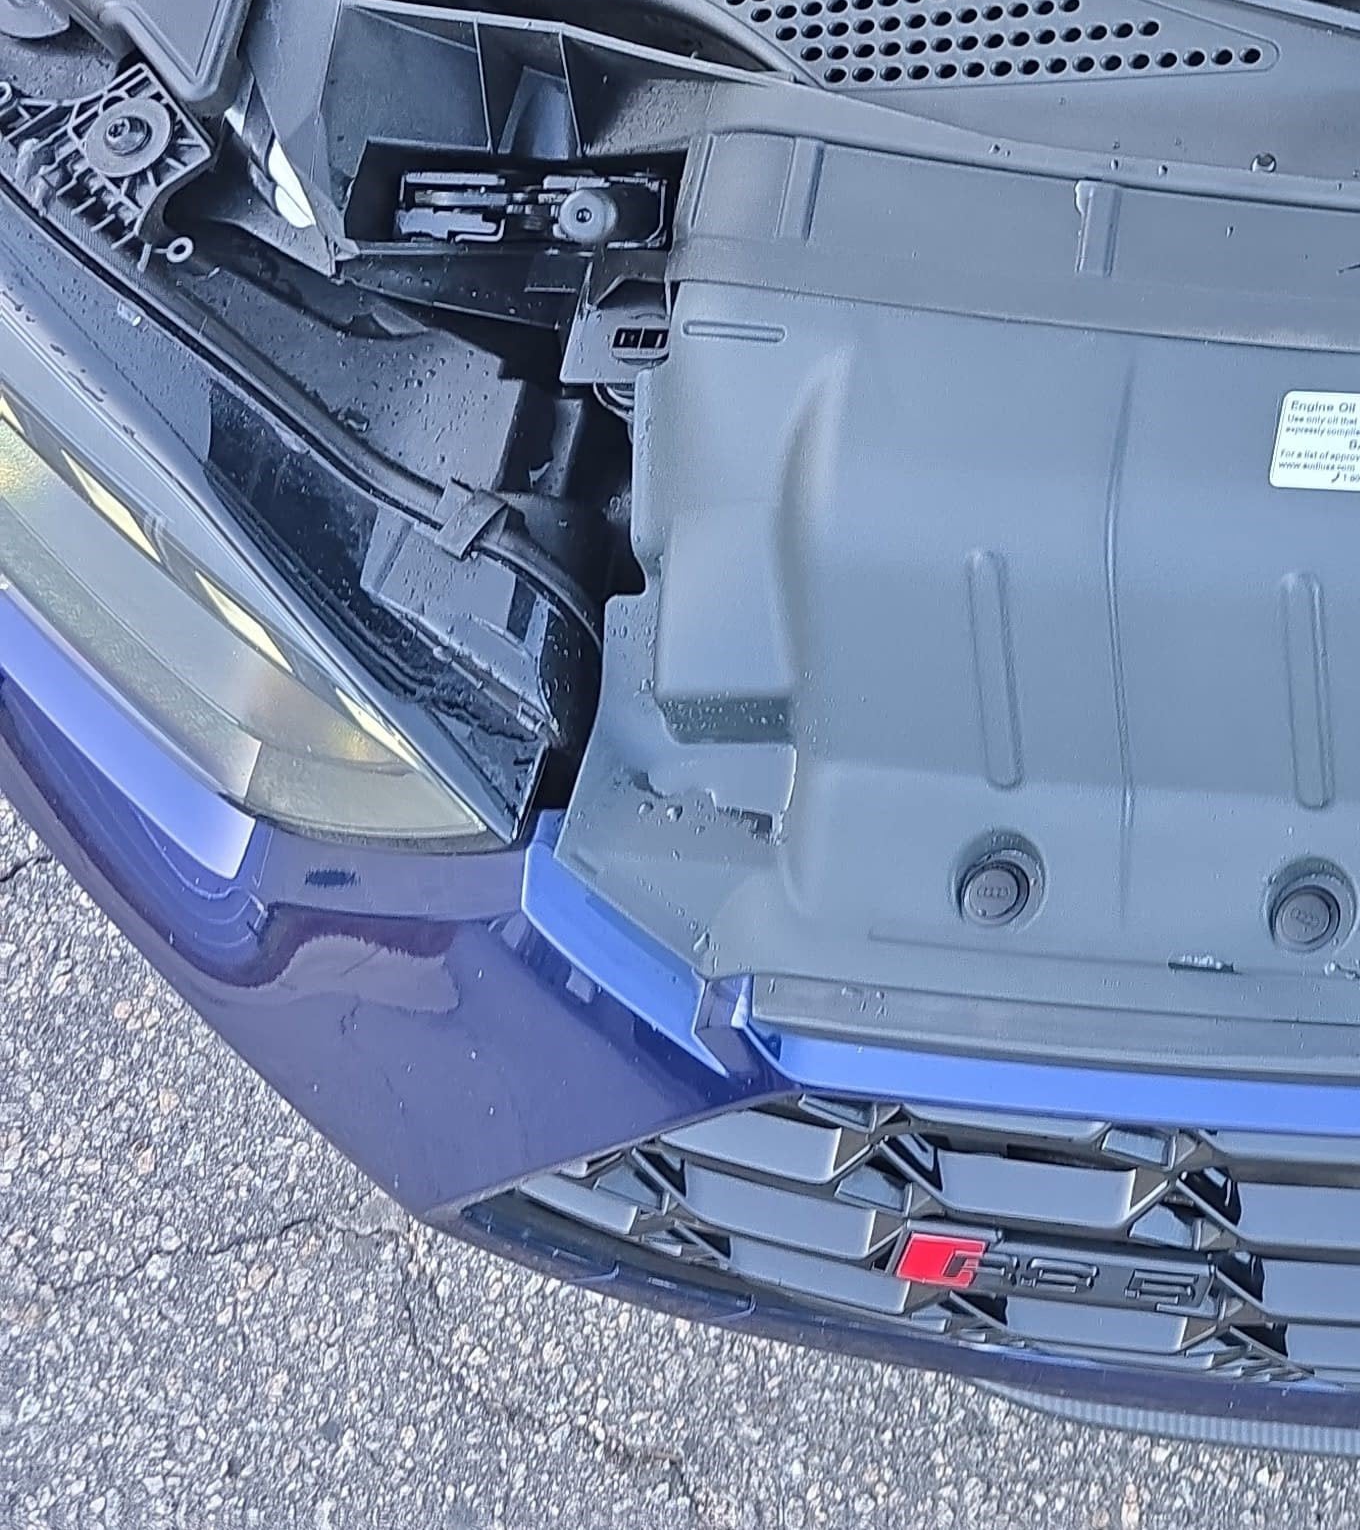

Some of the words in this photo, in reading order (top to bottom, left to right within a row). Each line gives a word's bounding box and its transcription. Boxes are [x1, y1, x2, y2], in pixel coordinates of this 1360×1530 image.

[1290, 400, 1335, 413] Engine
[1338, 402, 1357, 413] Oil
[1123, 1267, 1202, 1307] 5
